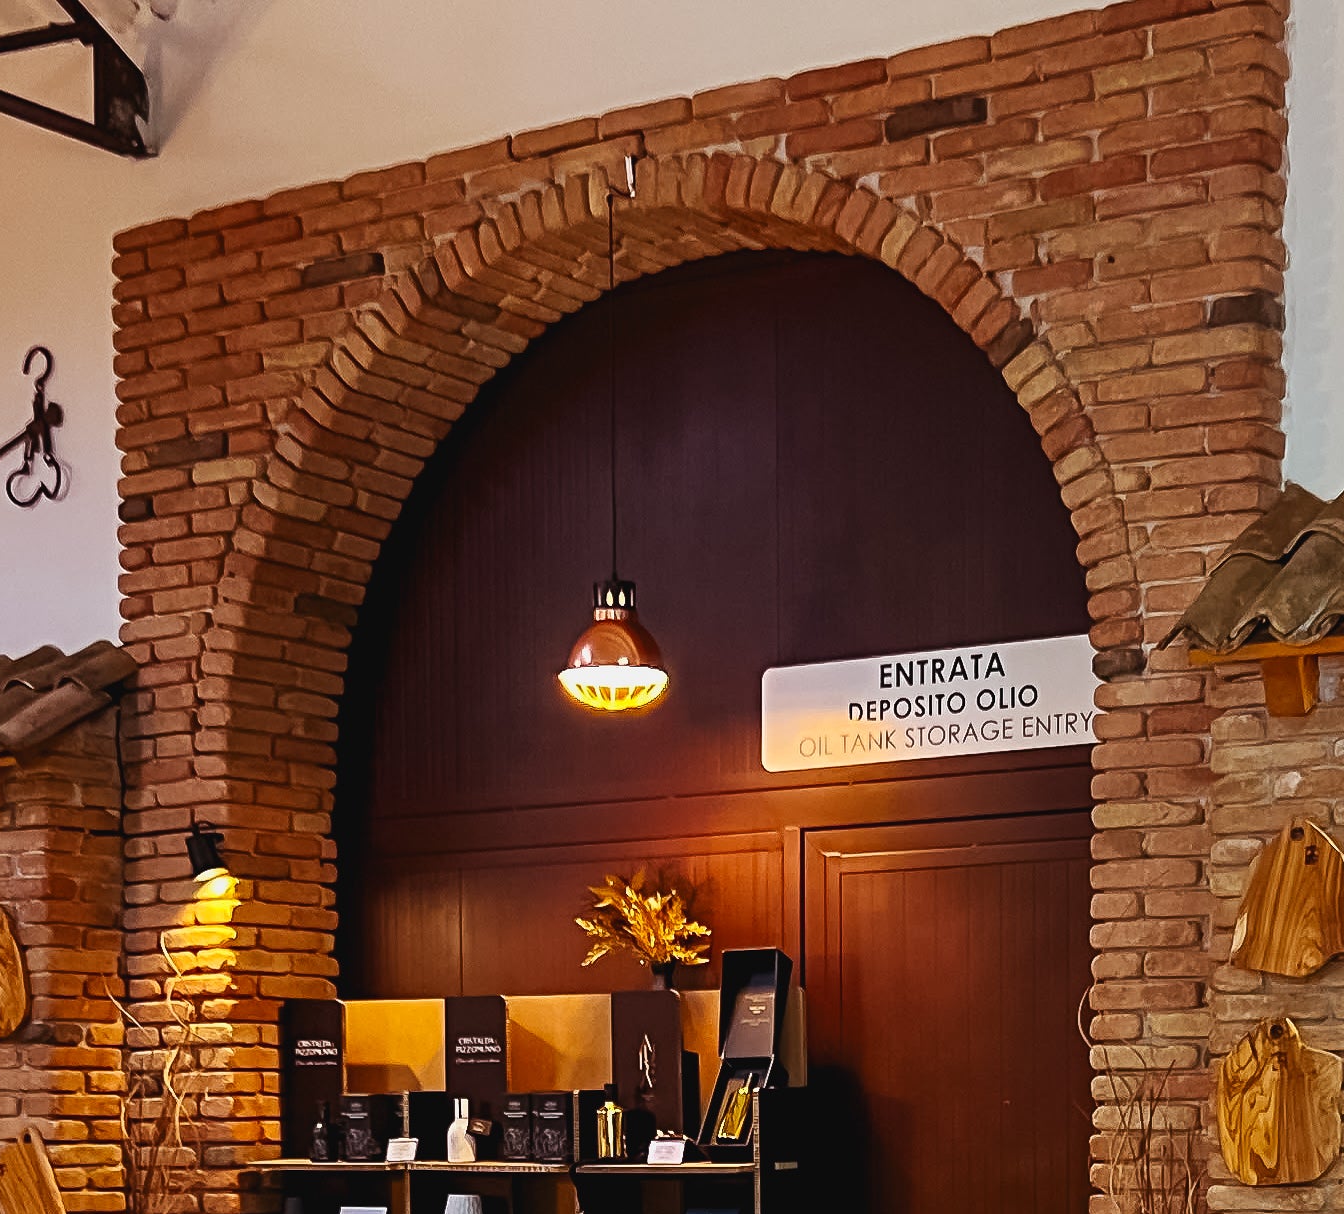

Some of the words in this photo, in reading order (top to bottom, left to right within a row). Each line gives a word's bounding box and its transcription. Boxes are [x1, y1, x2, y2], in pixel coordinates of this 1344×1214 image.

[879, 651, 1006, 690] ENTRATA
[847, 691, 966, 722] DEPOSITO
[976, 684, 1039, 712] OLIO
[798, 736, 833, 758] OIL
[841, 728, 897, 754] TANK
[904, 718, 1014, 749] STORAGE
[1022, 710, 1094, 738] ENTRY
